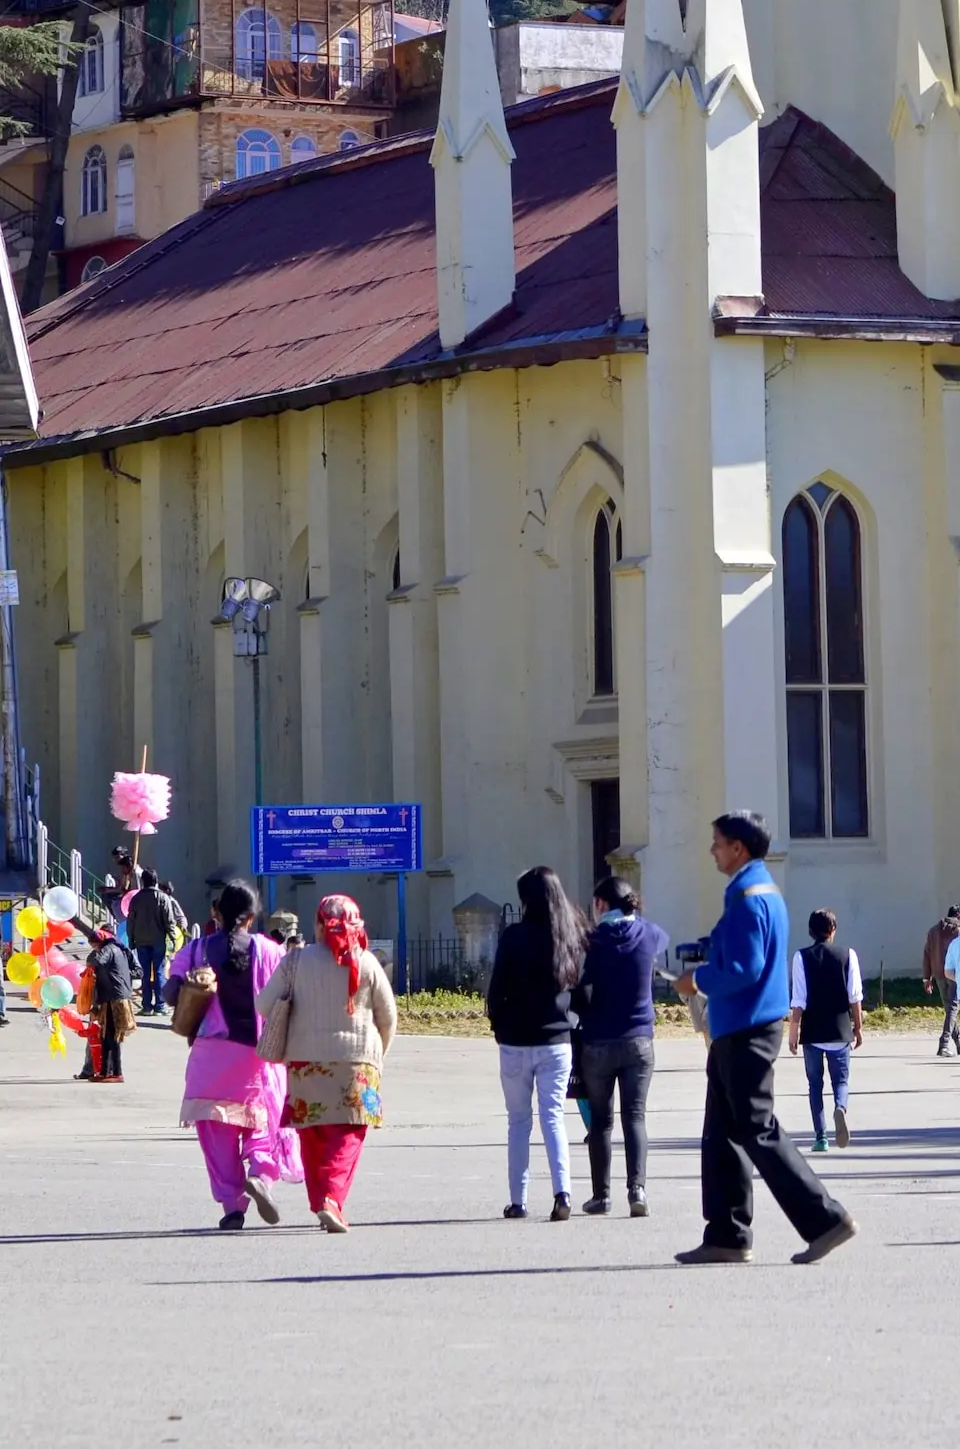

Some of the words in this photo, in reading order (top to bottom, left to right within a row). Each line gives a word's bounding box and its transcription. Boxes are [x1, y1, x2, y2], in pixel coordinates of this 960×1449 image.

[288, 809, 319, 817] CHRIST
[320, 808, 355, 816] CHURCH
[355, 807, 388, 815] SHIMLA
